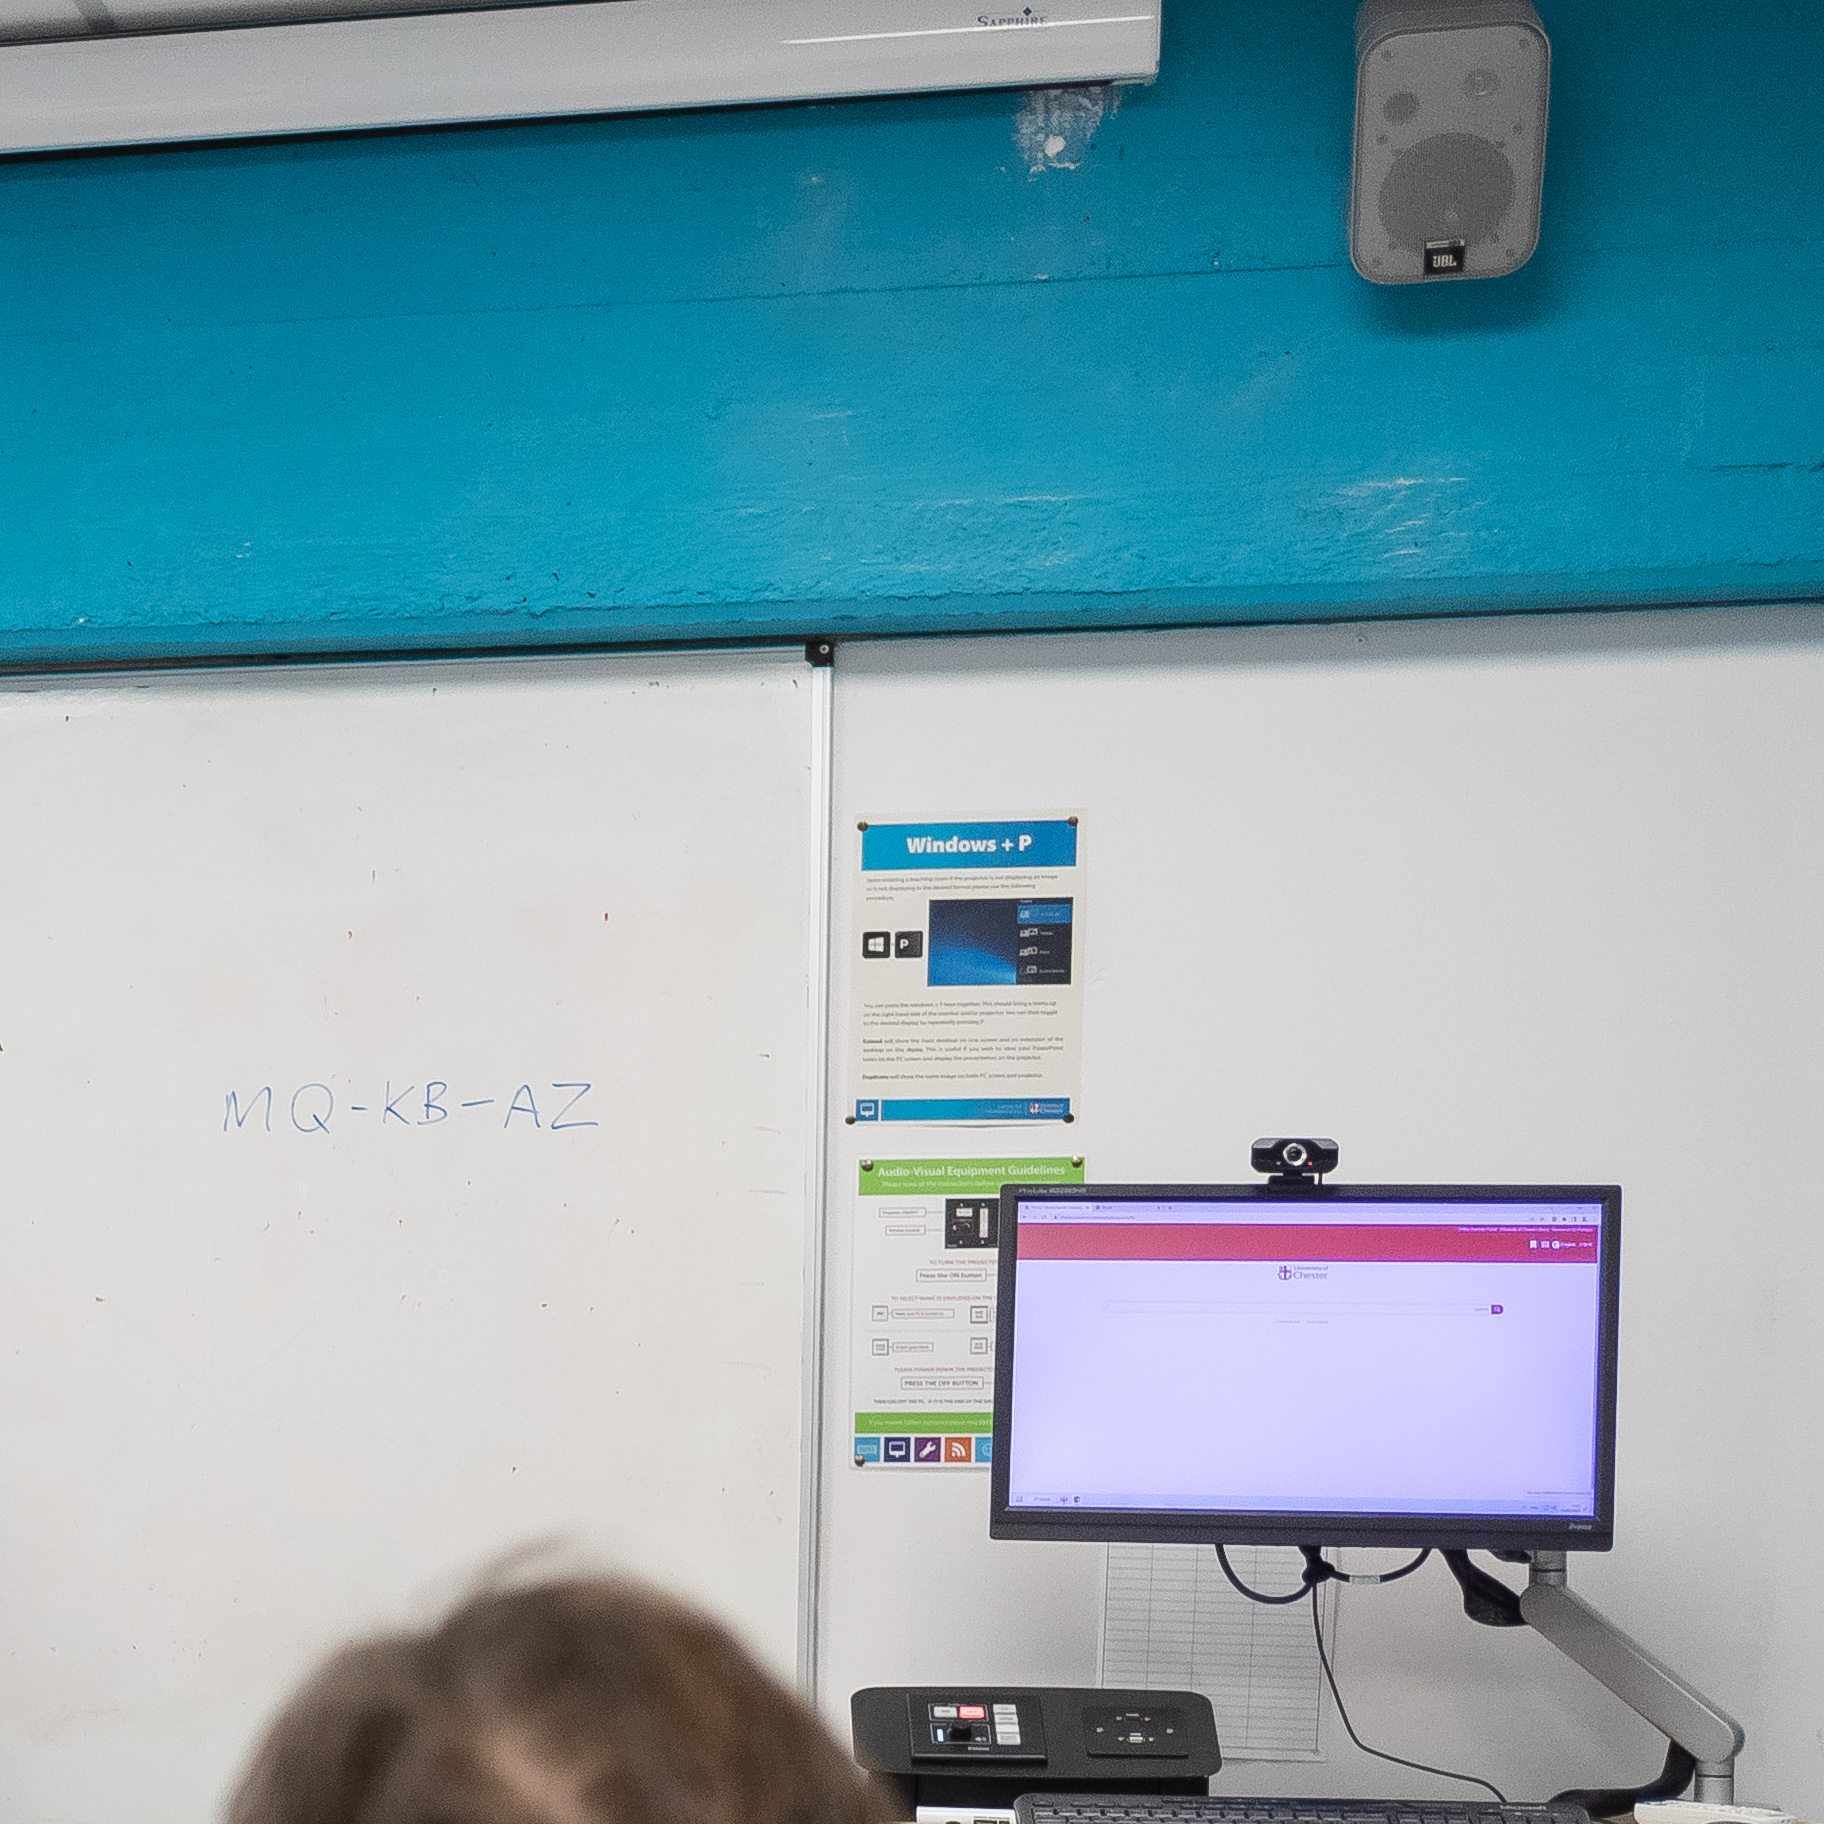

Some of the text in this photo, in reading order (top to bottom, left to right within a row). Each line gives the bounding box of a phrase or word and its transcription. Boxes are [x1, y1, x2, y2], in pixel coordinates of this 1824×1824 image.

[1432, 255, 1457, 267] JBL
[905, 835, 998, 856] Windows
[1017, 833, 1034, 853] P
[222, 1080, 600, 1135] MQ-KB-AZ
[946, 1166, 1006, 1178] Equipment
[1007, 1164, 1066, 1176] Guidelines
